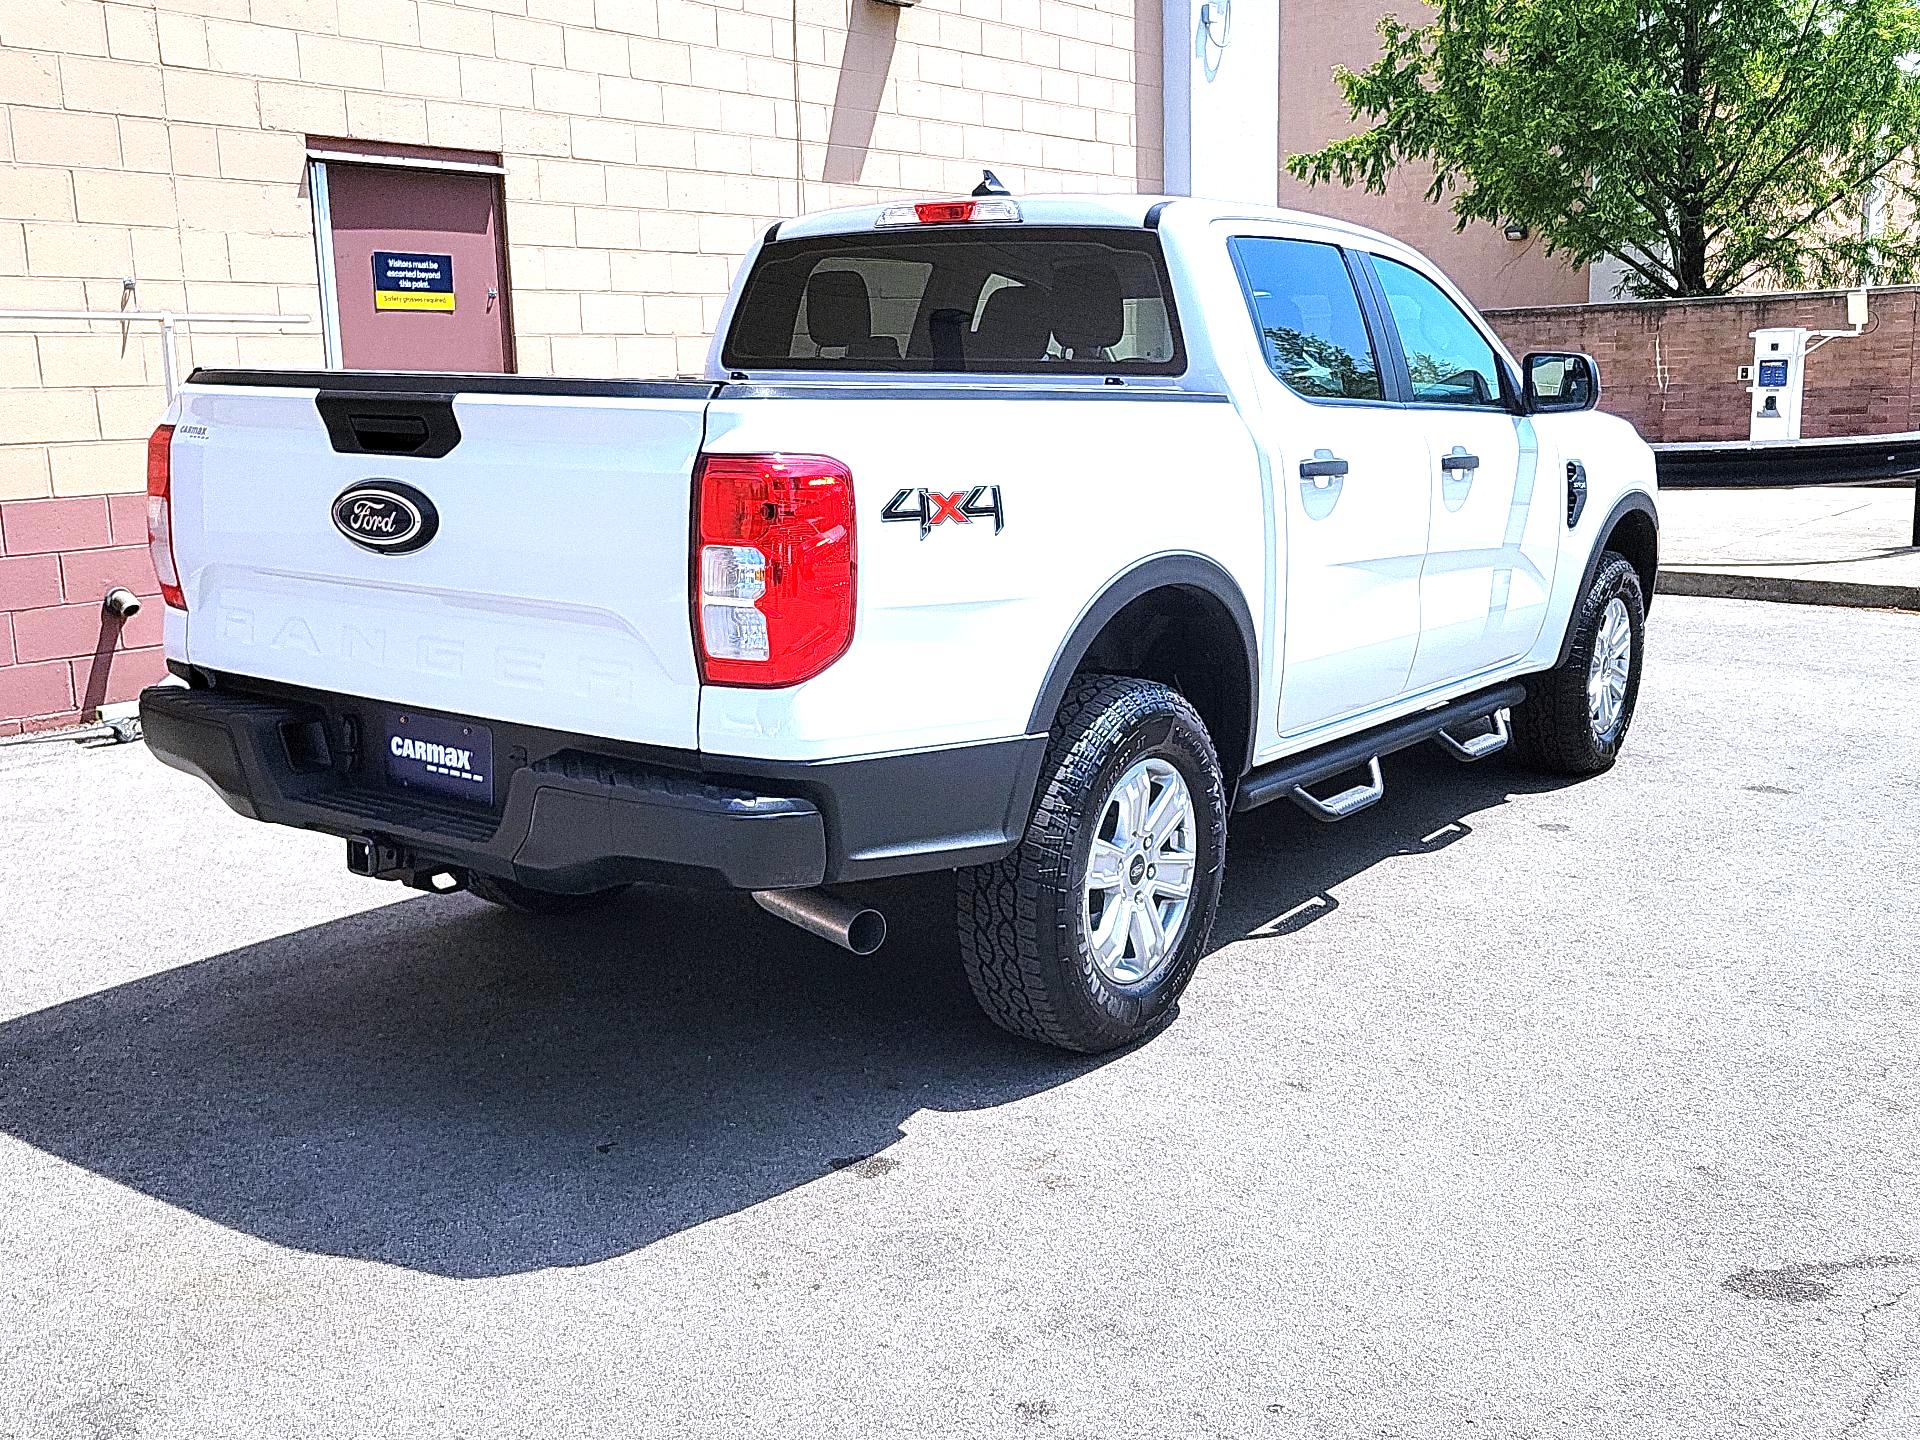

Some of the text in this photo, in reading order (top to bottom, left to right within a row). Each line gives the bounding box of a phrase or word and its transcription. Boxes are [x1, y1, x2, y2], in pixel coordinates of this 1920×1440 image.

[388, 258, 438, 269] Visitors must be
[387, 270, 440, 280] escorted beyond
[399, 279, 430, 289] this point.
[384, 295, 402, 303] Safety
[350, 499, 397, 533] Ford
[880, 484, 1005, 542] 4x4
[215, 604, 634, 700] RANGER
